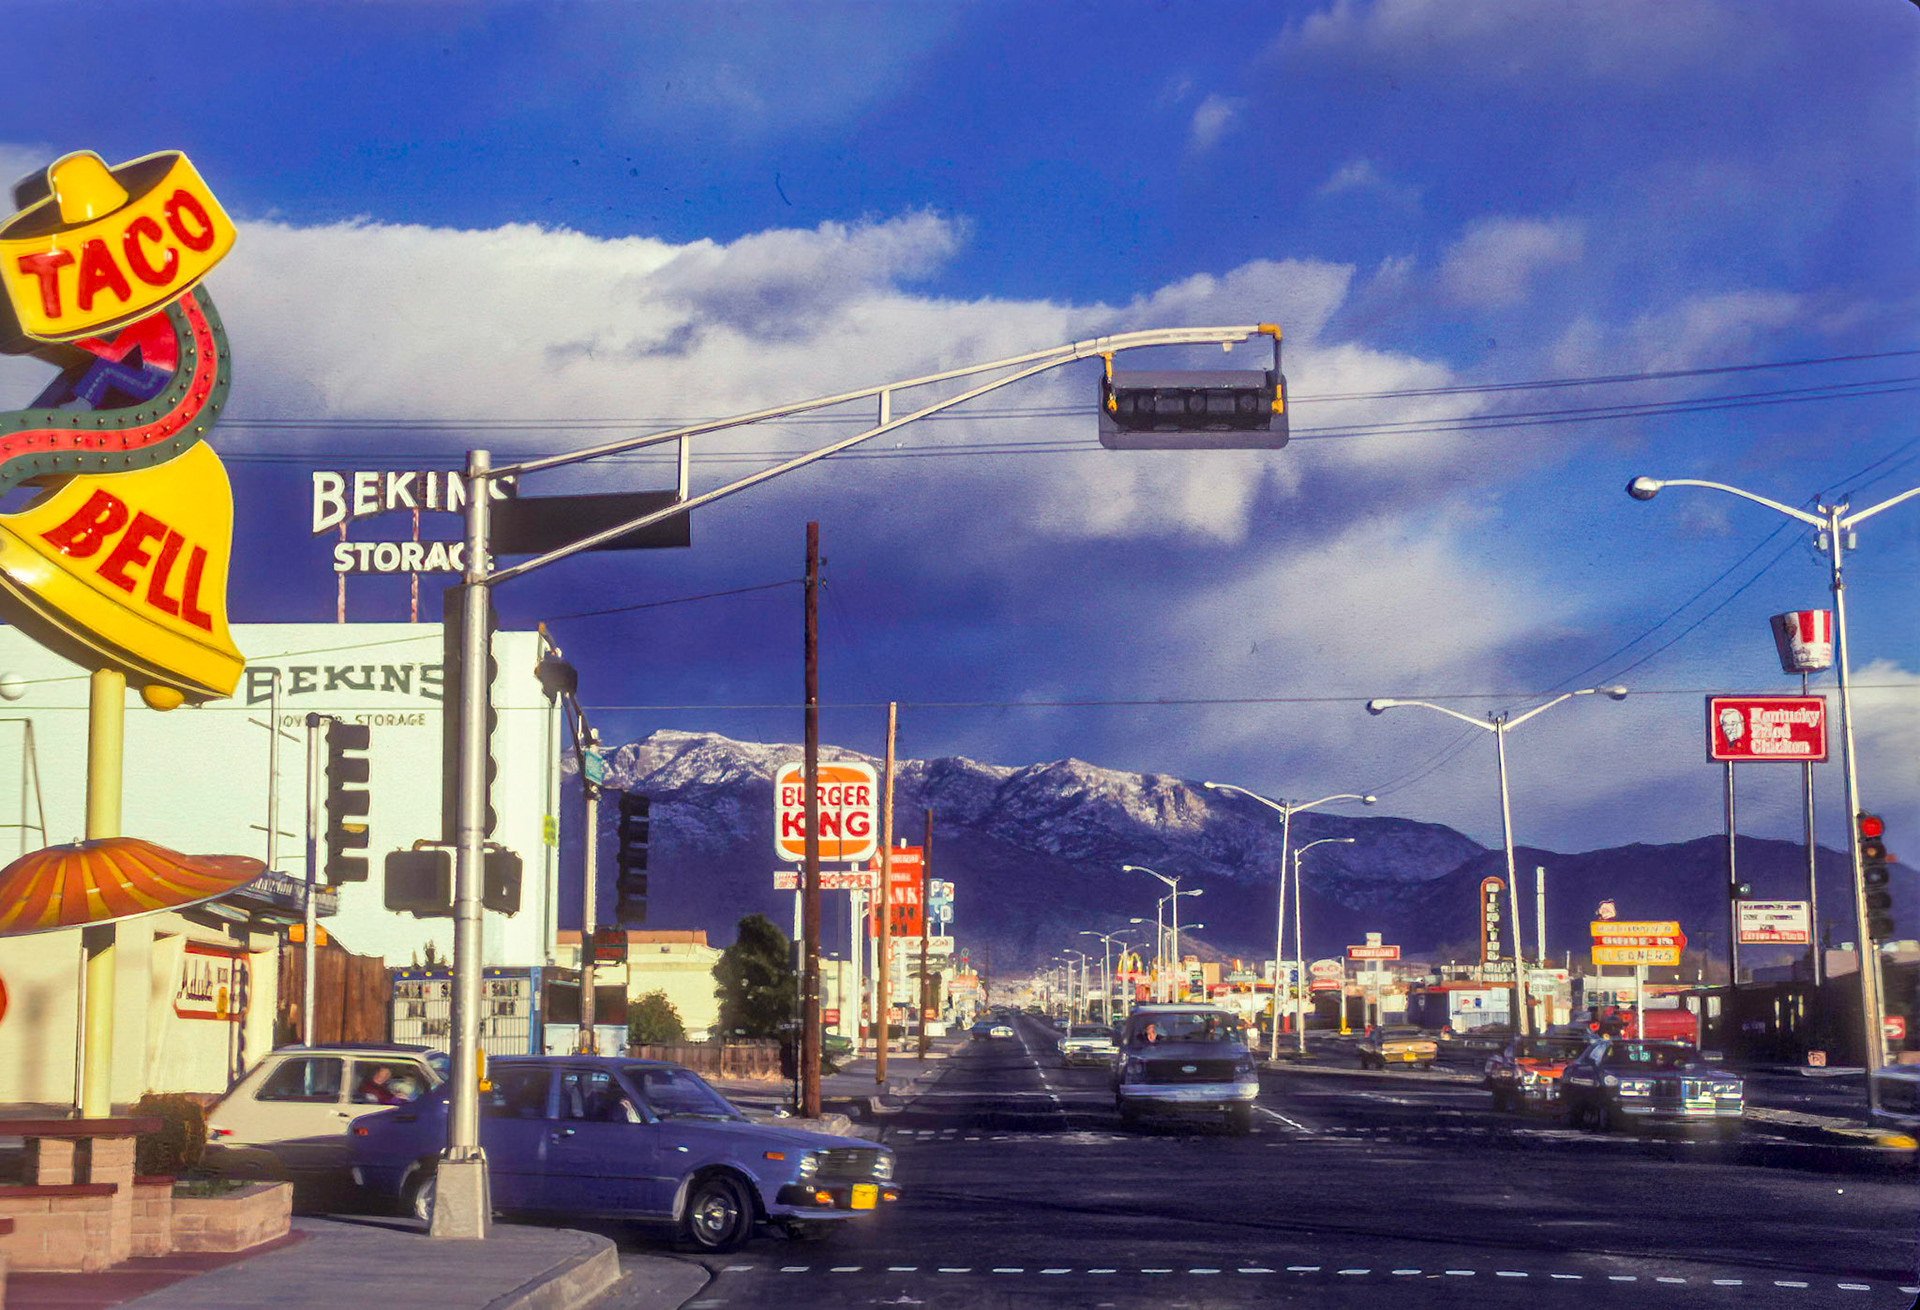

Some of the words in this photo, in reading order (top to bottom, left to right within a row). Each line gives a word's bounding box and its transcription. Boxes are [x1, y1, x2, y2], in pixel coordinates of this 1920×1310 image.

[20, 189, 215, 319] TACO
[41, 489, 213, 633] BELL
[333, 542, 494, 572] STORAG
[244, 664, 443, 706] BEKINS
[355, 713, 427, 726] STORAGE
[782, 811, 870, 838] KNG
